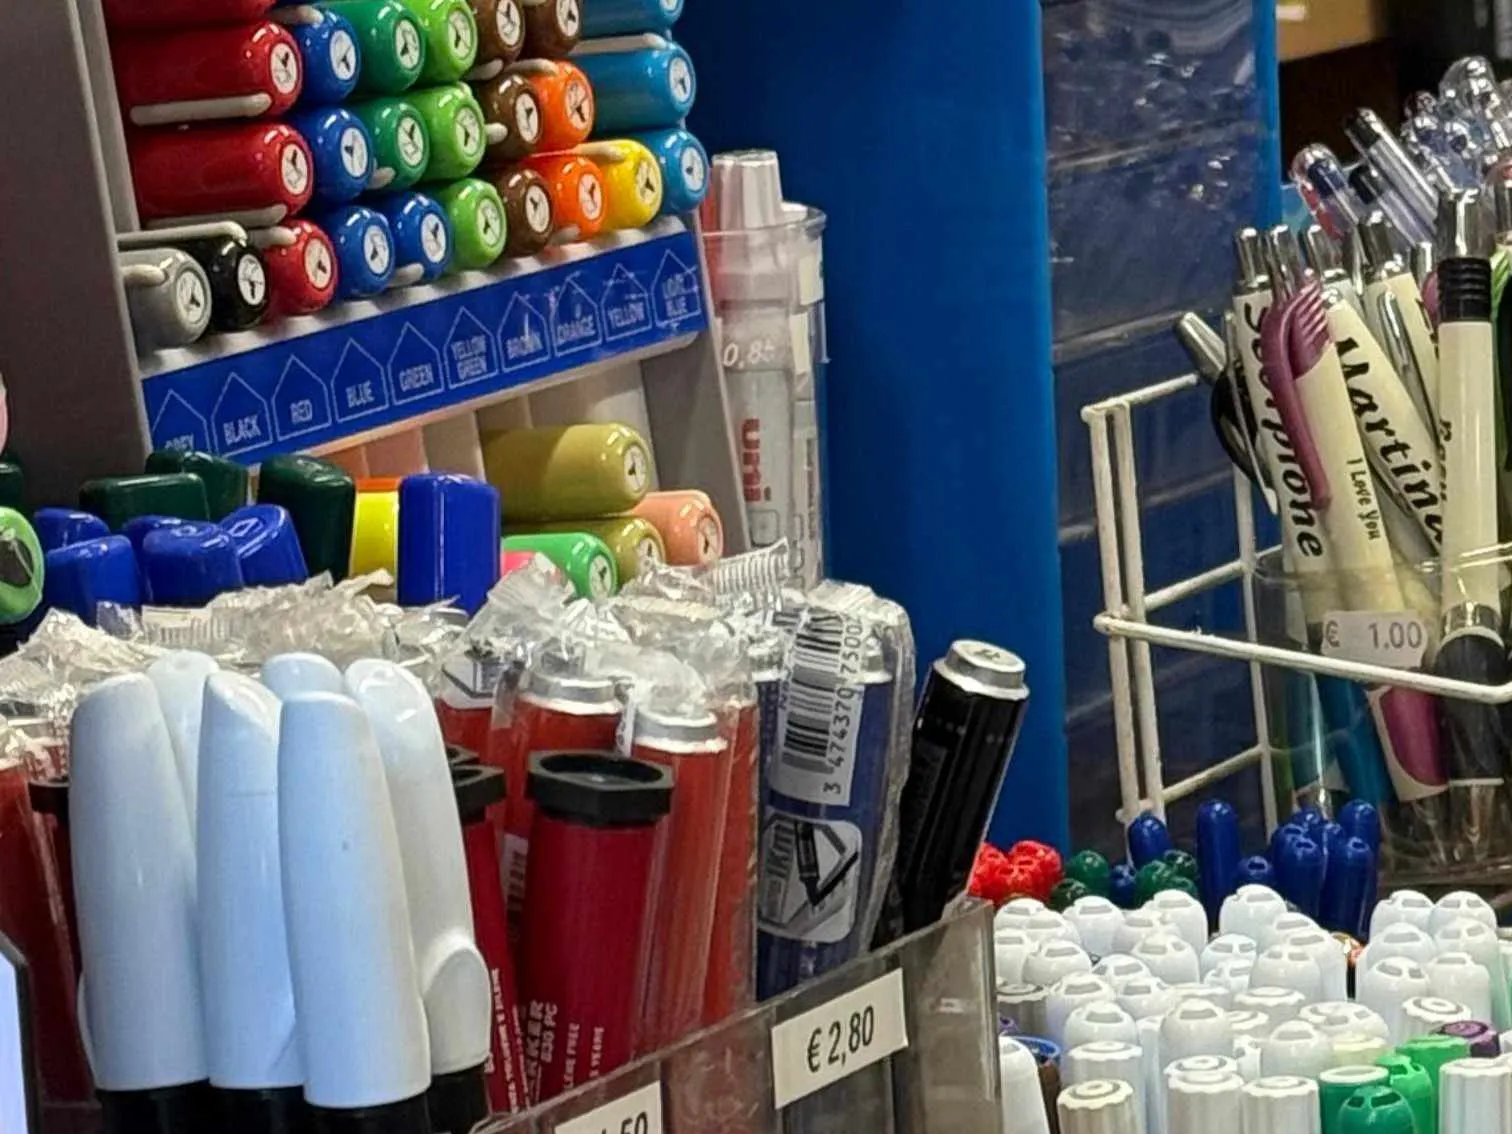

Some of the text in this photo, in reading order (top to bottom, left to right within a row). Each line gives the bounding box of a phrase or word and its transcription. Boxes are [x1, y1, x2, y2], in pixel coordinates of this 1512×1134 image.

[608, 301, 645, 328] YELLOW
[556, 316, 596, 344] ORANGE
[506, 332, 543, 360] BROWN
[399, 361, 434, 392] GREEN
[456, 356, 487, 380] GREEN
[346, 380, 374, 408] BLUE
[290, 400, 312, 424] RED
[224, 415, 261, 445] BLACK
[1324, 622, 1423, 651] € 1.00
[806, 1004, 875, 1075] € 2,80
